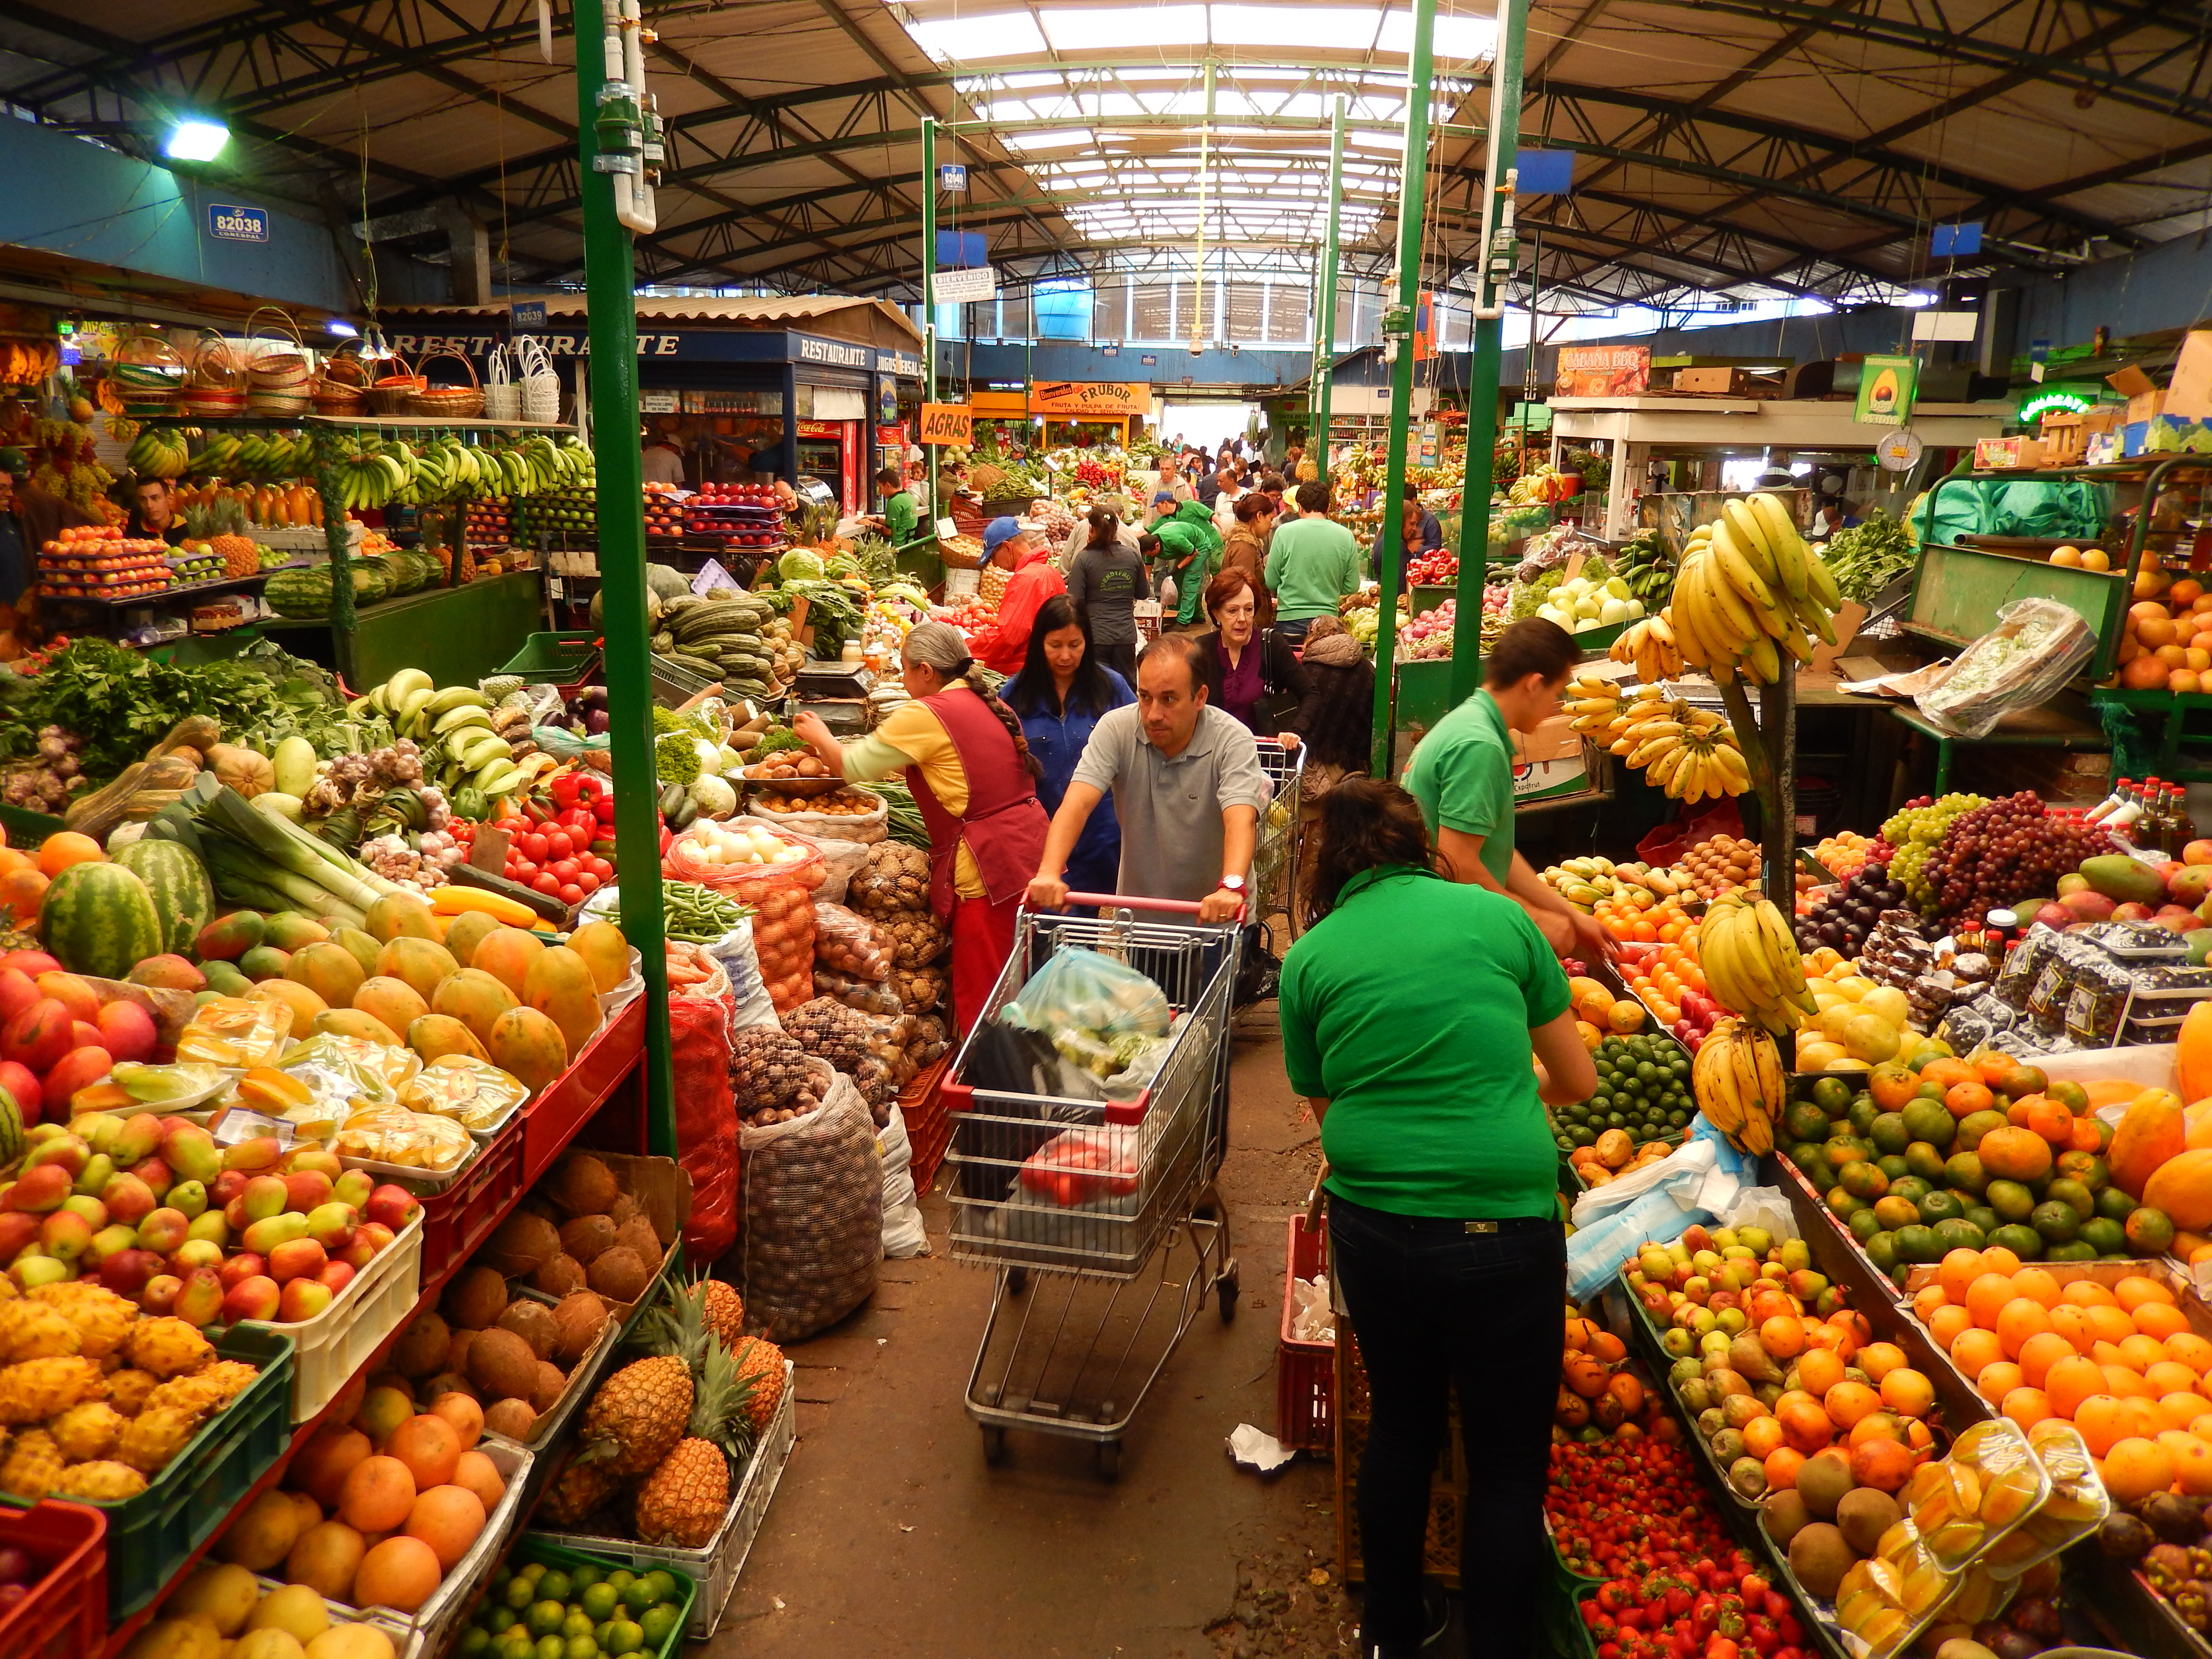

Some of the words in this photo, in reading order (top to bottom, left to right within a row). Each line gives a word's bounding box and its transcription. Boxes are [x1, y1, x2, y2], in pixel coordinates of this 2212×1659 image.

[945, 173, 963, 184] 82040
[217, 216, 262, 233] 82038
[937, 272, 988, 284] BIENVENIDO
[517, 311, 542, 322] 82039
[394, 335, 680, 356] RESTAURATE
[801, 339, 865, 366] RESTAURANTE
[877, 356, 896, 372] JUGOS
[1565, 350, 1609, 370] CABAÑA
[1612, 351, 1639, 370] BBQ
[1040, 386, 1072, 400] Bienvenidos
[1080, 384, 1131, 403] FRUBOR
[925, 412, 970, 438] AGRAS
